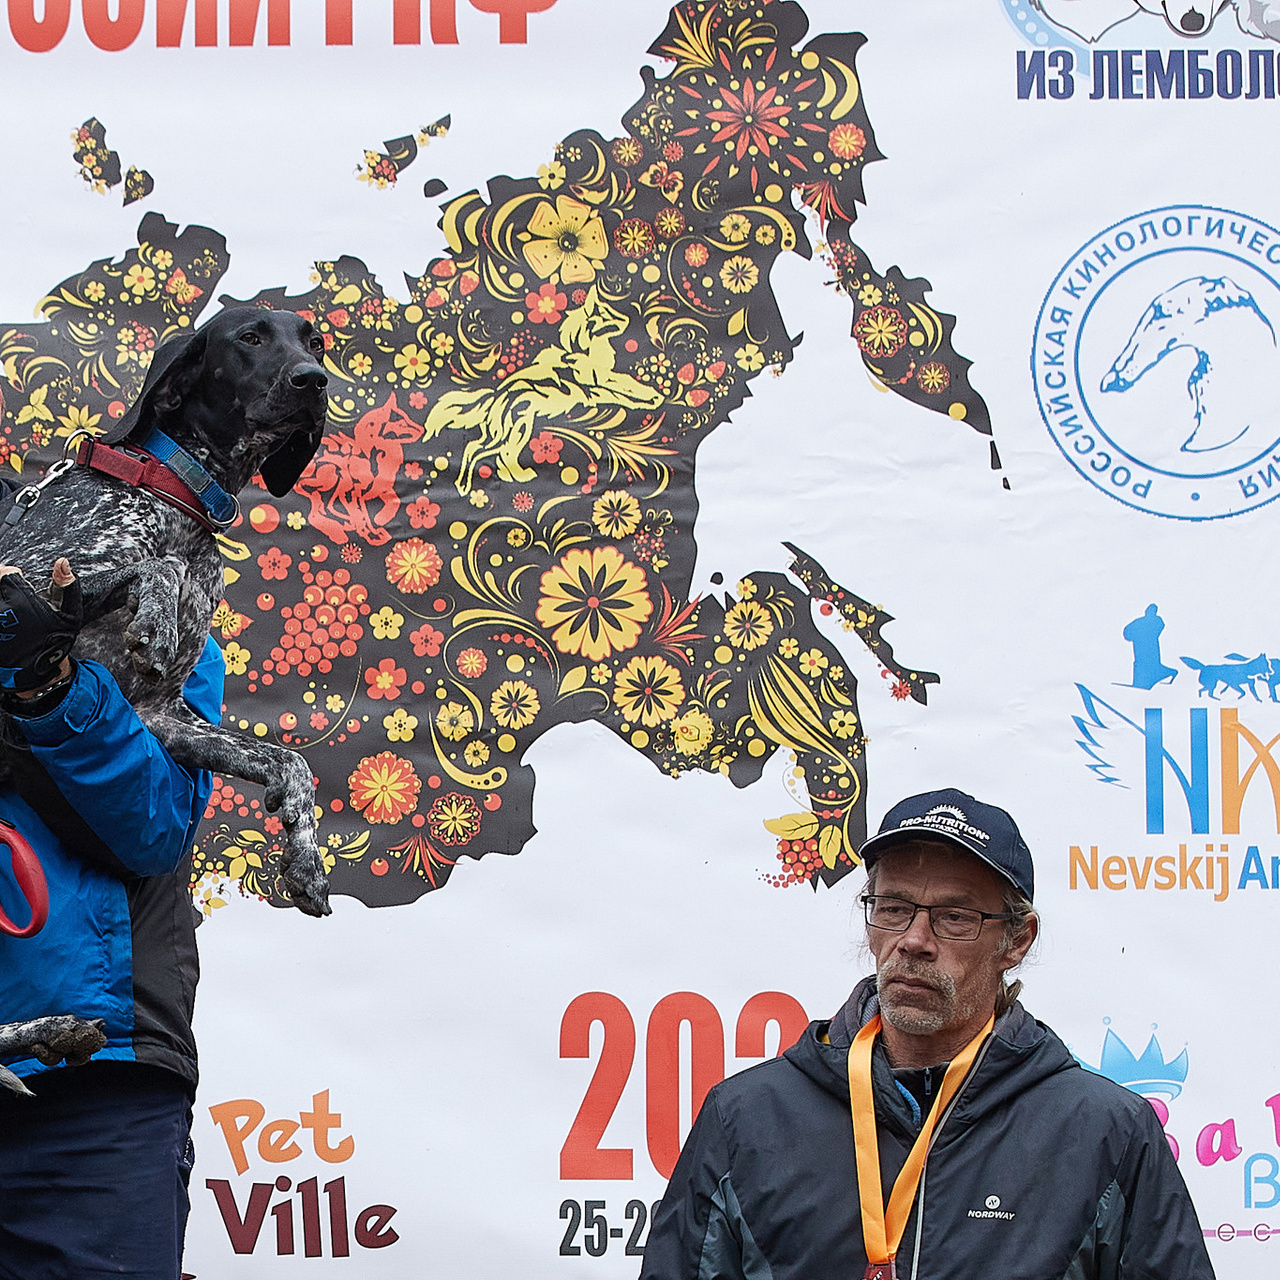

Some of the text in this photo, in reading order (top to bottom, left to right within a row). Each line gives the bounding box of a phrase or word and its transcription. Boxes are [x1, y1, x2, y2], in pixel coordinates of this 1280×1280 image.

[1016, 50, 1074, 100] ИЗ
[1043, 306, 1152, 498] РОССИЙСКАЯ
[1069, 843, 1230, 902] Nevskij
[559, 991, 812, 1181] 20
[208, 1088, 355, 1176] Pet
[205, 1175, 400, 1259] Ville
[559, 1199, 662, 1257] 25-2
[968, 1210, 1015, 1221] NORDWAY
